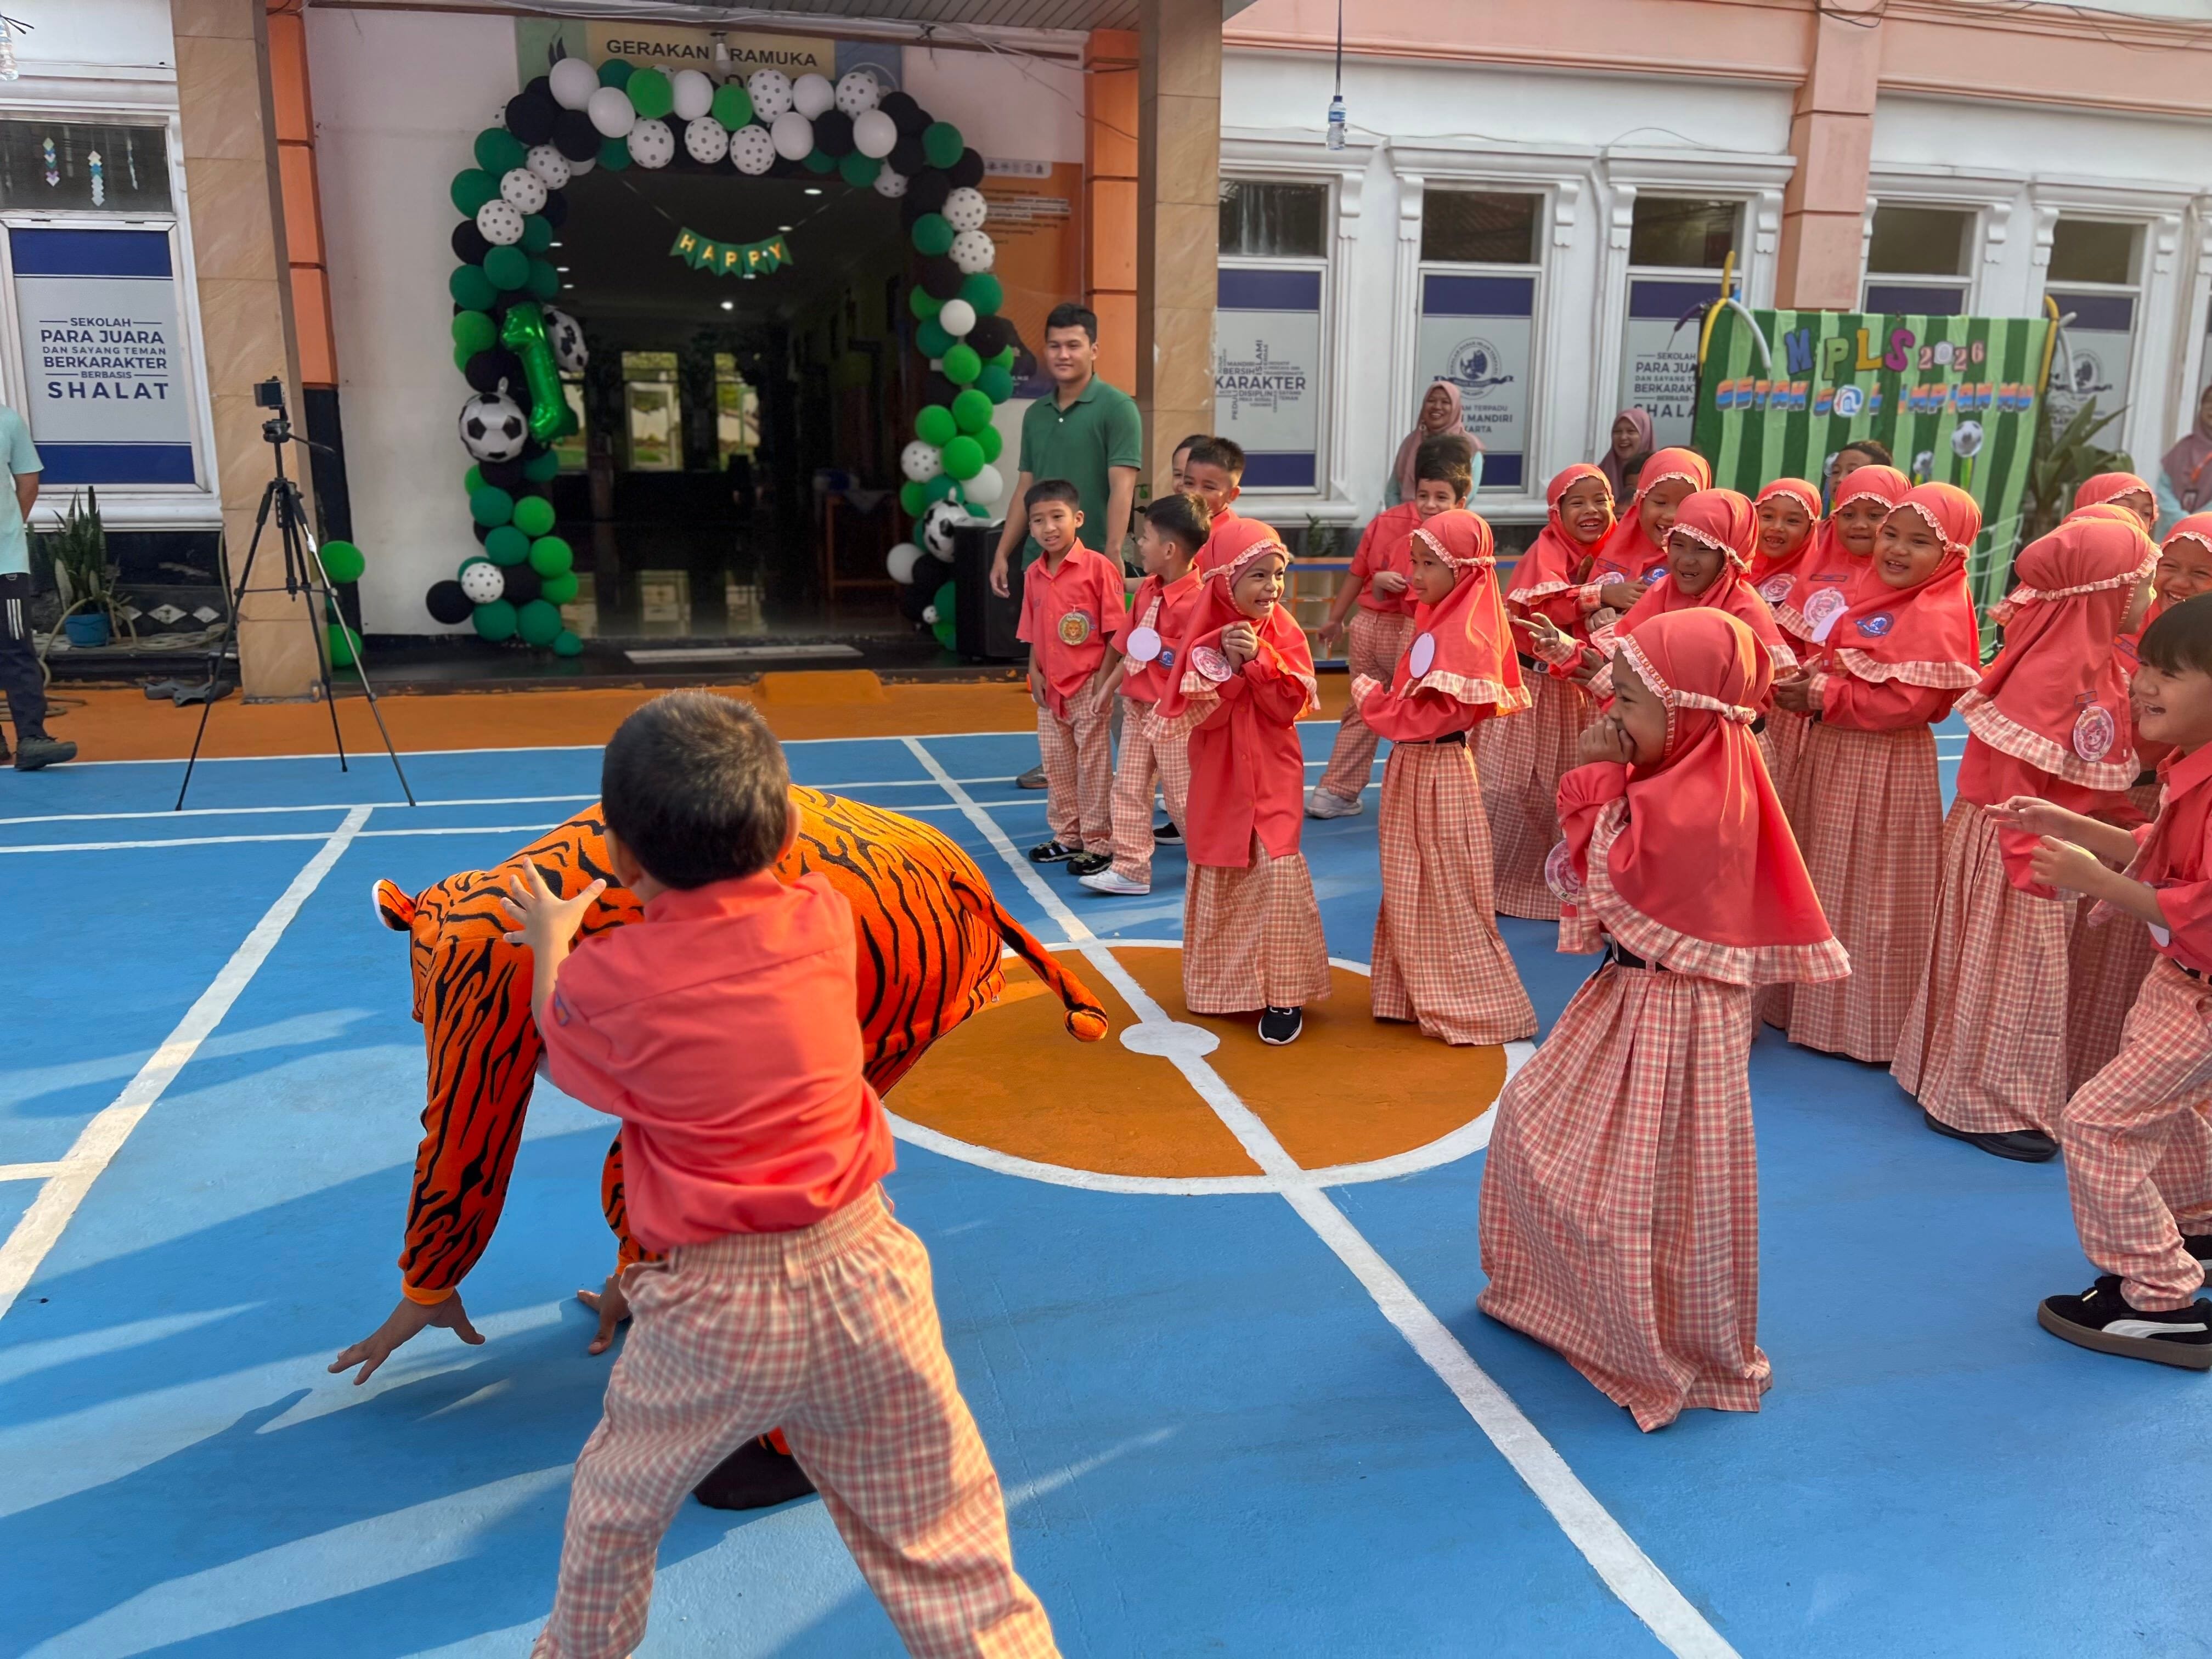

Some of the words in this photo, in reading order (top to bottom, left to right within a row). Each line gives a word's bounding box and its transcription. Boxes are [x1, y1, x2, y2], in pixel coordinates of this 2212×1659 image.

[607, 39, 709, 60] GERAKAN
[726, 48, 818, 67] RAMUKA
[680, 234, 781, 267] HAPPY
[70, 318, 132, 327] SEKOLAH
[41, 329, 94, 343] PARA
[99, 330, 165, 344] JUARA
[72, 346, 120, 354] SAYANG
[1785, 328, 1916, 381] MPLS
[1918, 340, 1984, 371] 2026
[44, 356, 168, 369] BERKARAKTER
[1636, 362, 1669, 373] PARA
[48, 381, 168, 399] SHALAT
[1215, 376, 1306, 390] KARAKTER
[1467, 414, 1513, 422] MANDIRI
